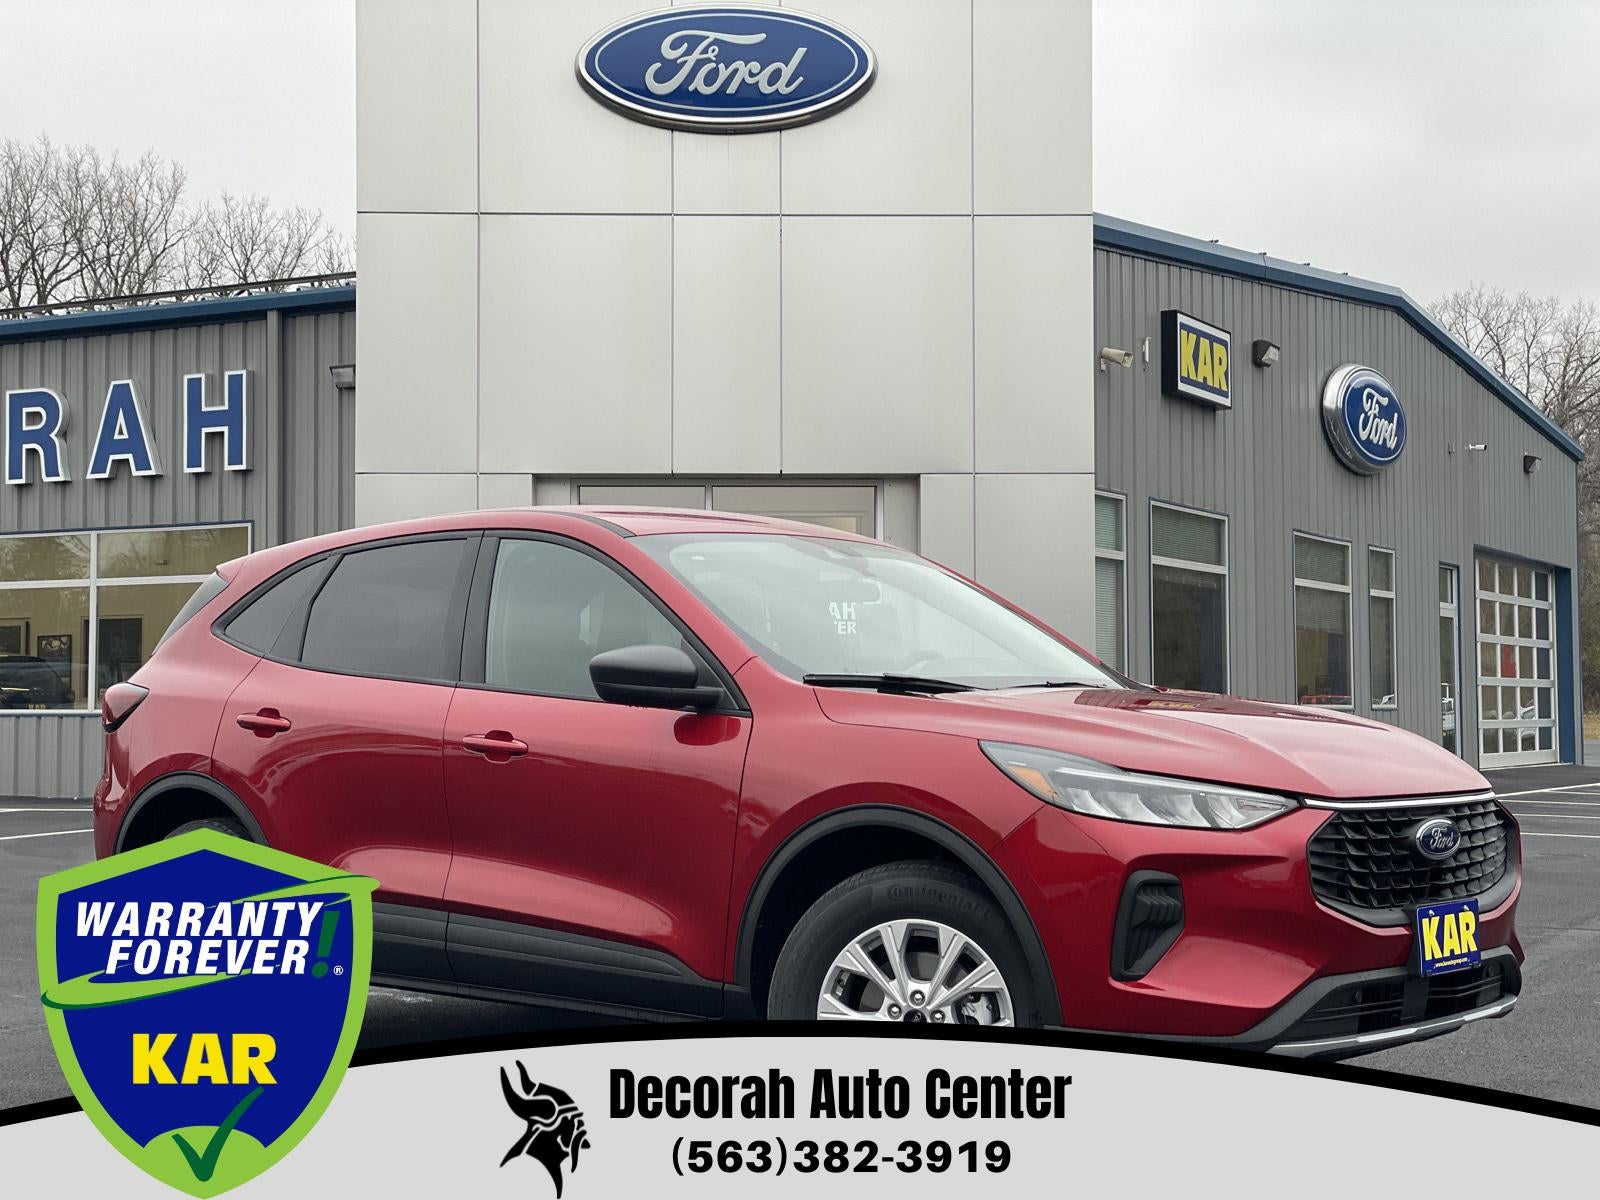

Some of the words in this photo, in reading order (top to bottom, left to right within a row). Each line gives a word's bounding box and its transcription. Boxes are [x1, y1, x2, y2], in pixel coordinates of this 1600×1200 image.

[645, 30, 807, 95] Ford
[1180, 329, 1228, 391] KAR
[5, 369, 253, 484] RAH
[1358, 387, 1398, 450] Ford
[834, 621, 857, 634] ER
[1430, 827, 1454, 848] Ford
[1422, 911, 1477, 961] KAR
